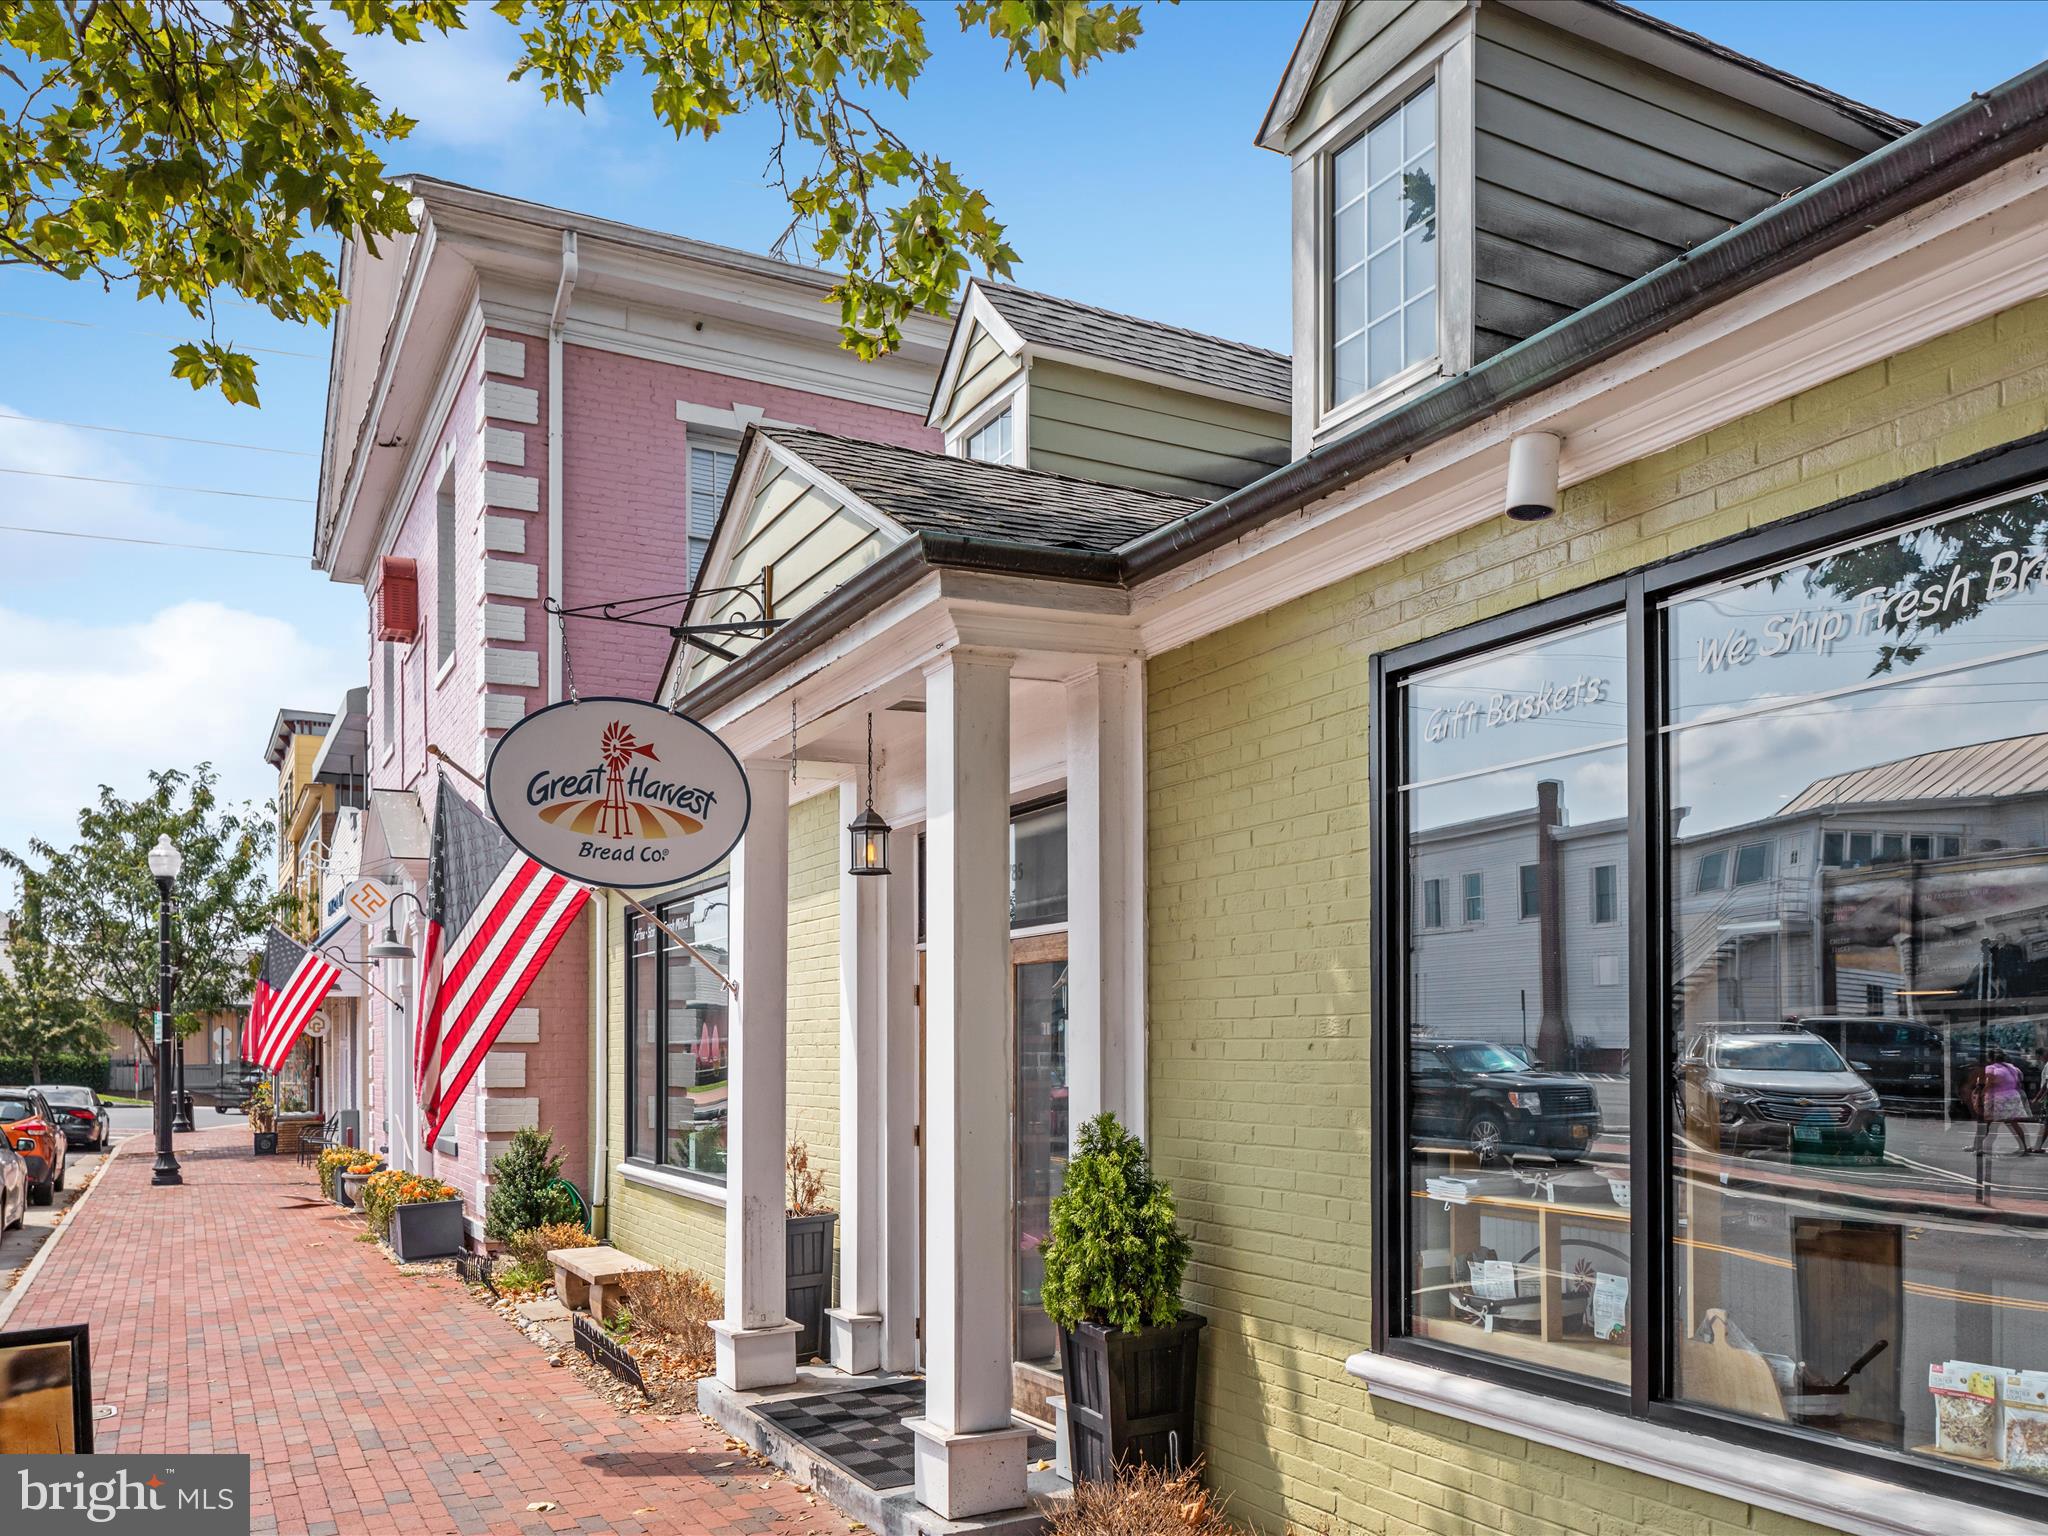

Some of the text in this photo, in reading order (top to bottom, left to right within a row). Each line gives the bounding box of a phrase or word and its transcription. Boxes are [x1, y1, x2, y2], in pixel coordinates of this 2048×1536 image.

[1697, 628, 1749, 673] We
[1759, 607, 1843, 656] Ship
[1854, 565, 1970, 635] Fresh
[1424, 674, 1604, 743] Gift Baskets
[527, 763, 718, 821] Great Harvest
[578, 841, 635, 862] Bread
